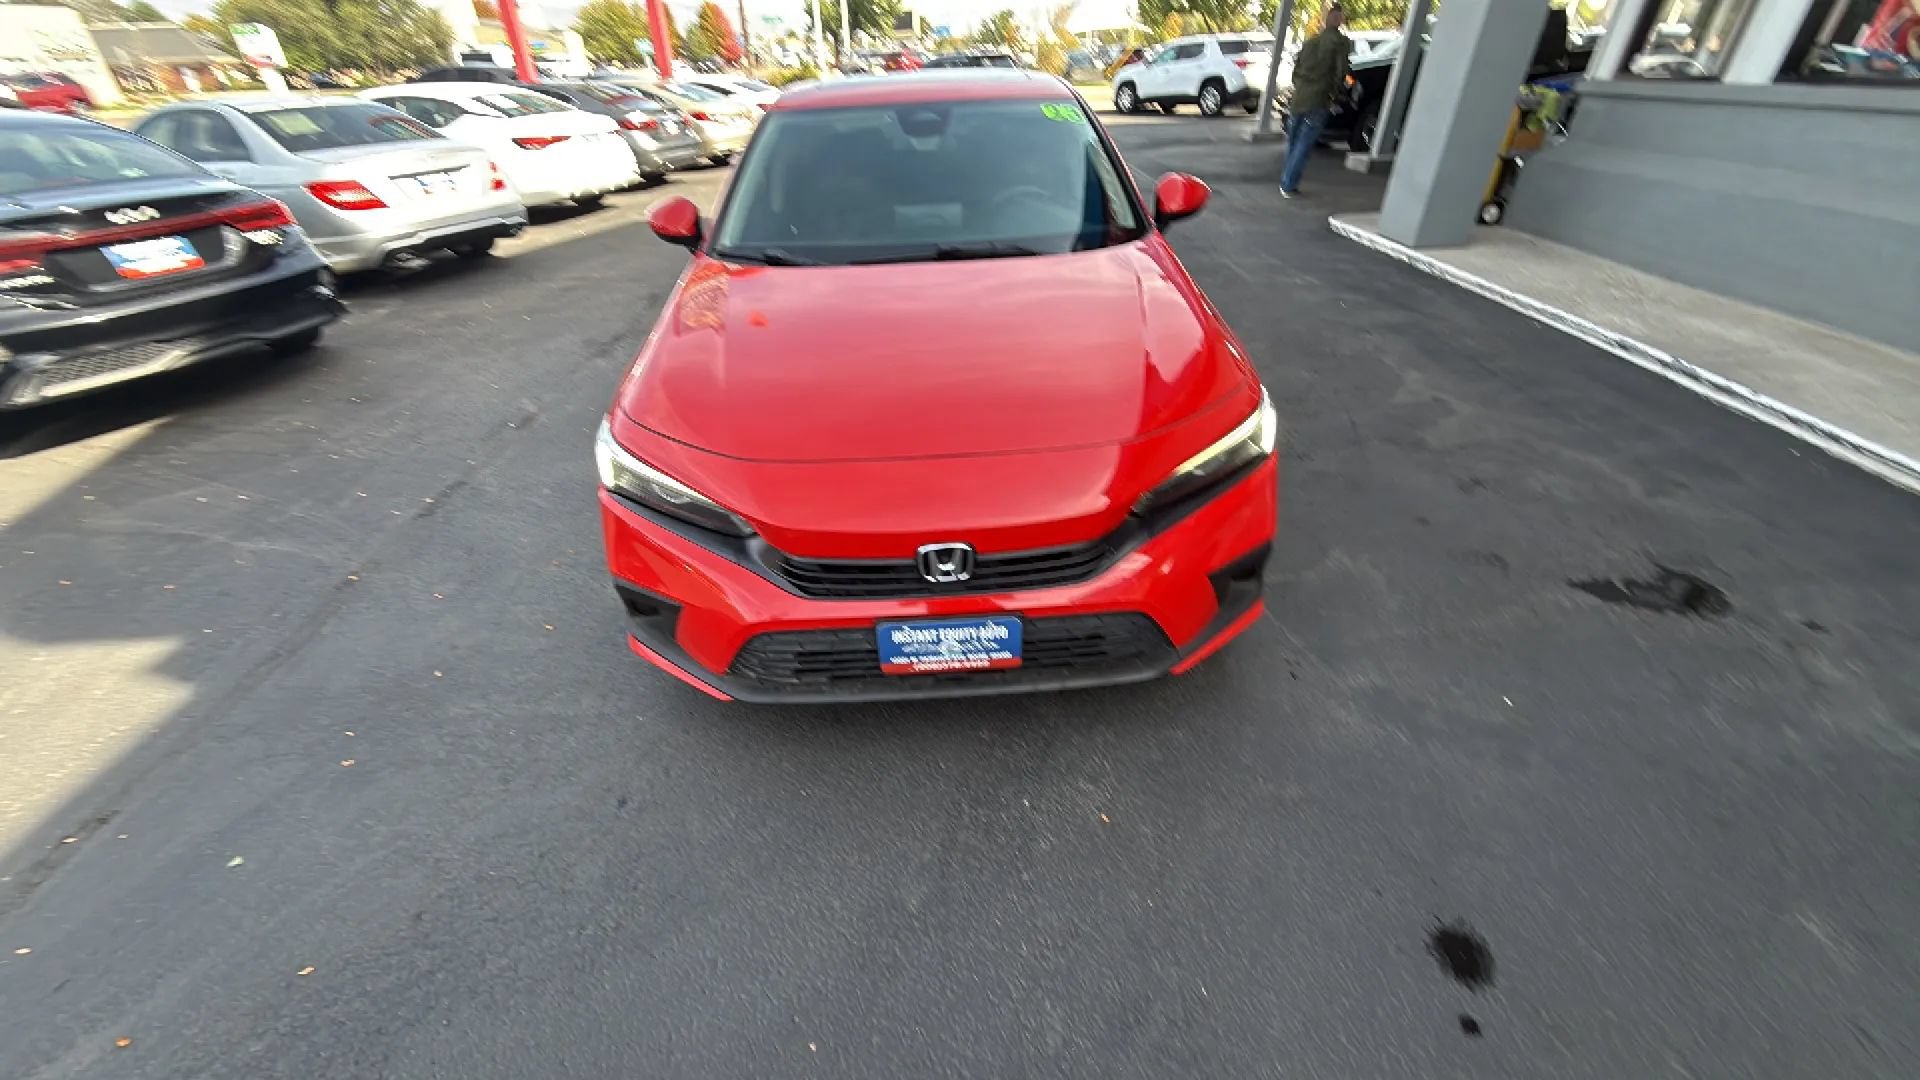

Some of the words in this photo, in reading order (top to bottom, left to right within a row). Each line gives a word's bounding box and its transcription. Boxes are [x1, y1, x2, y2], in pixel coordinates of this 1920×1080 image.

[891, 628, 938, 643] INSTANT
[939, 627, 977, 641] EQUITY
[977, 624, 1008, 640] AUTO
